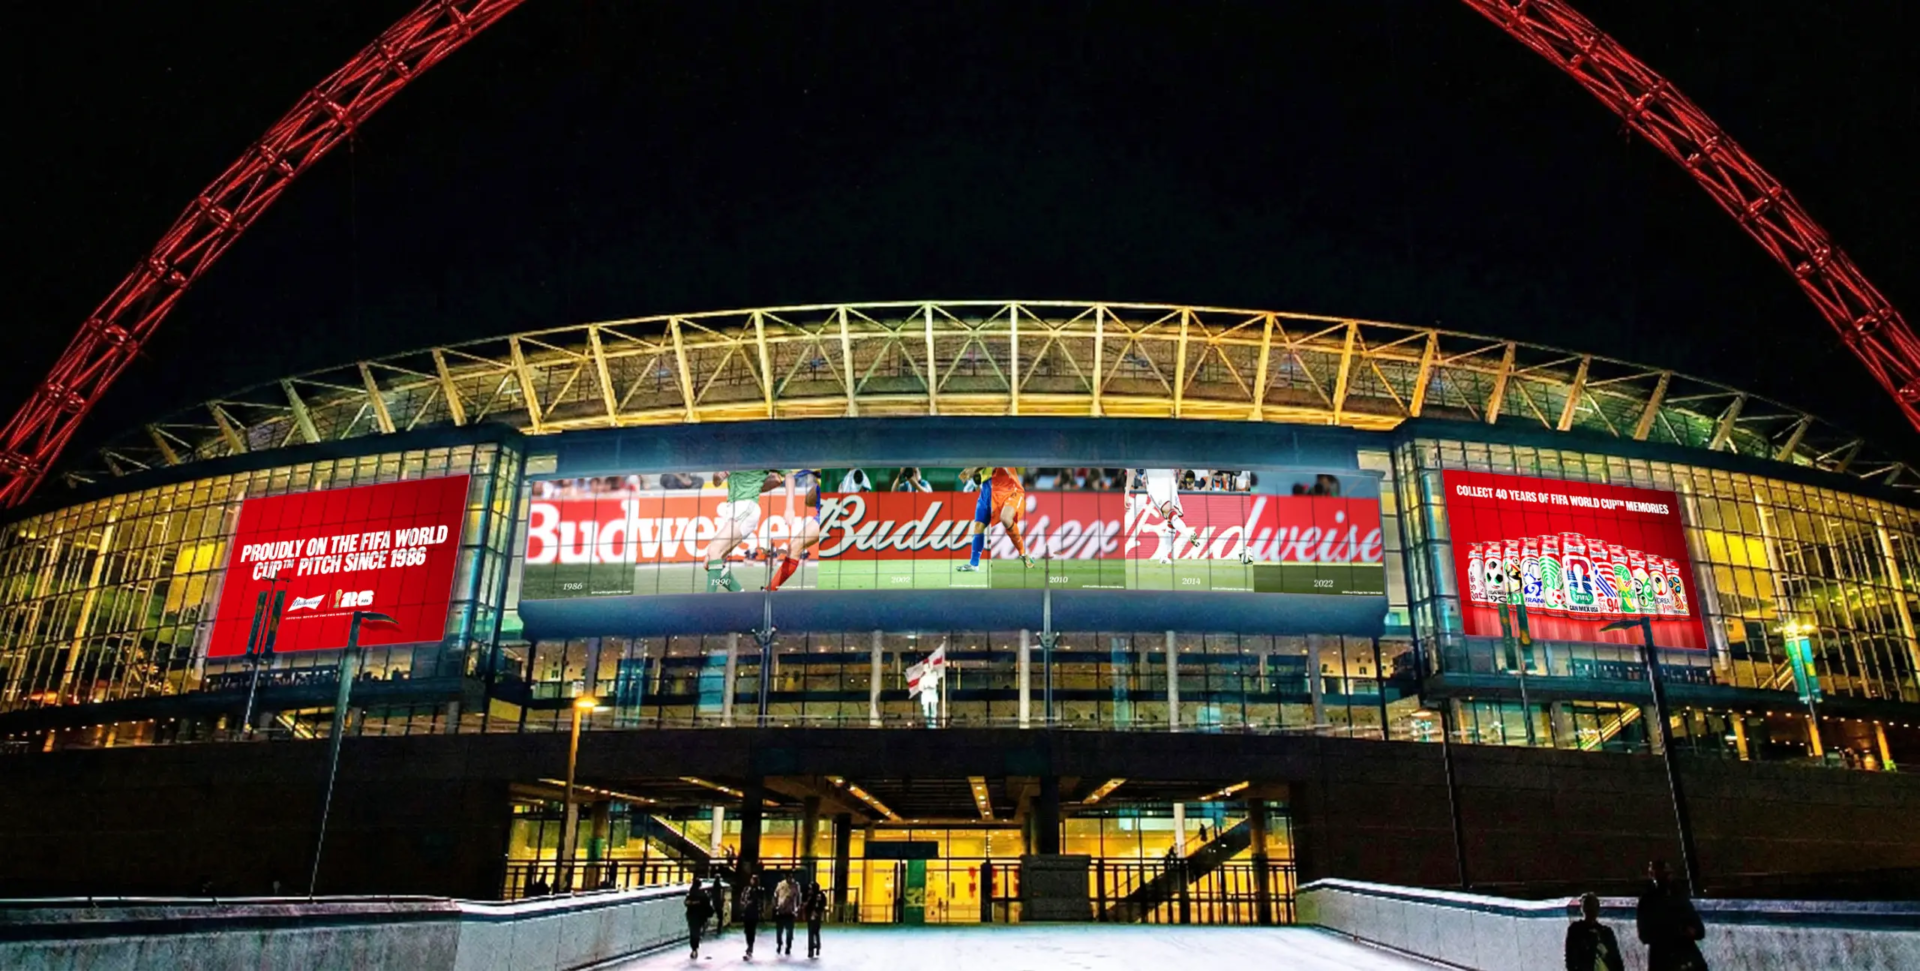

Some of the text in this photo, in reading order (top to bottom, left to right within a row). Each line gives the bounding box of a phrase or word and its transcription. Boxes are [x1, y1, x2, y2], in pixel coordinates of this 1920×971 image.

[1456, 485, 1493, 499] COLLECT
[1495, 489, 1508, 500] 40
[1509, 490, 1537, 503] YEARS
[1538, 493, 1550, 504] OF
[1551, 494, 1569, 506] FIFA
[1569, 496, 1600, 509] WORLD
[1626, 501, 1669, 515] MEMORIES
[240, 525, 448, 563] PROUDLY ON THE FIFA WORLD
[297, 554, 342, 577] PITCH
[343, 550, 386, 572] SINCE
[390, 546, 427, 567] 1986
[711, 578, 731, 586] 1990
[891, 576, 911, 584] 2002
[1049, 576, 1069, 584] 2010
[1182, 577, 1201, 586] 2014
[1314, 579, 1334, 588] 2022
[563, 582, 583, 591] 1986
